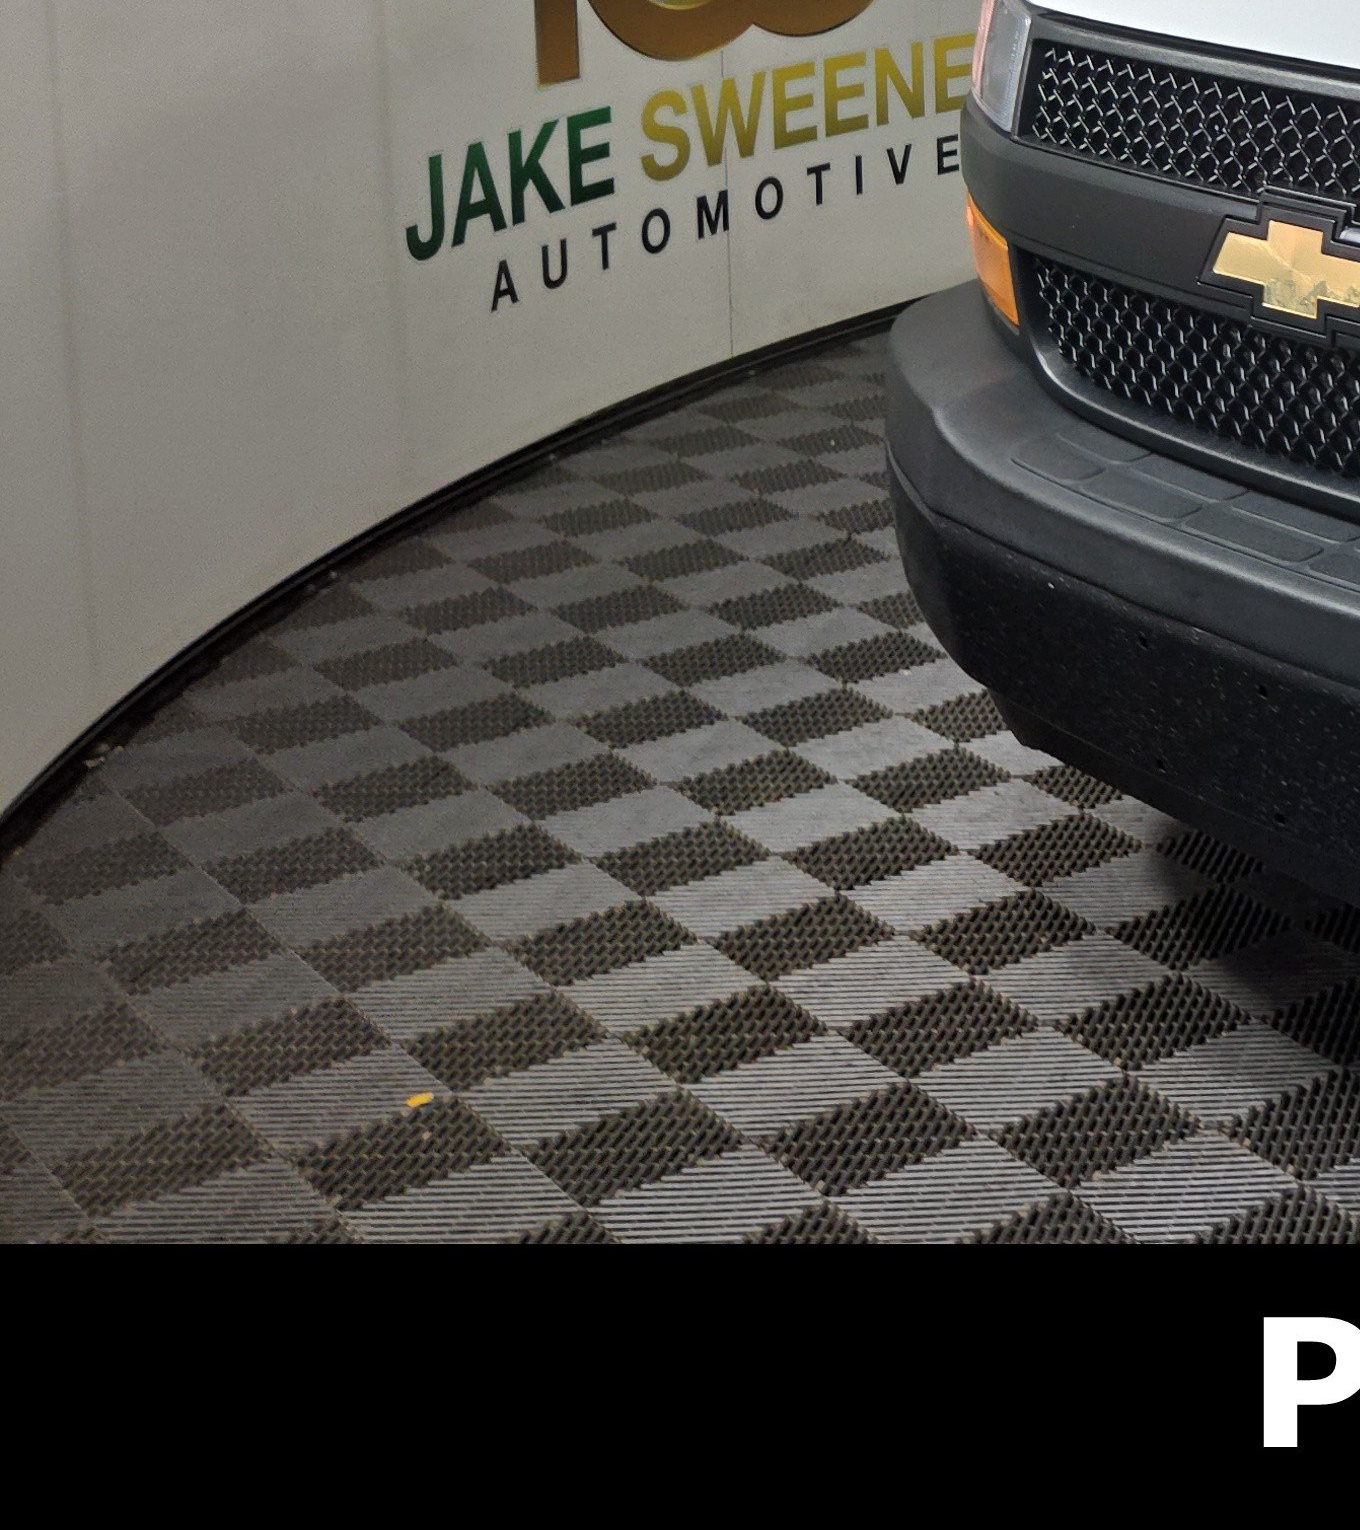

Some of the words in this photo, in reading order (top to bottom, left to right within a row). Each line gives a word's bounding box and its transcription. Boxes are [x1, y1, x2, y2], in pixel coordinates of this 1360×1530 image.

[405, 105, 616, 261] JAKE
[639, 32, 976, 182] SWEENE
[490, 133, 960, 313] AUTOMOTIVE
